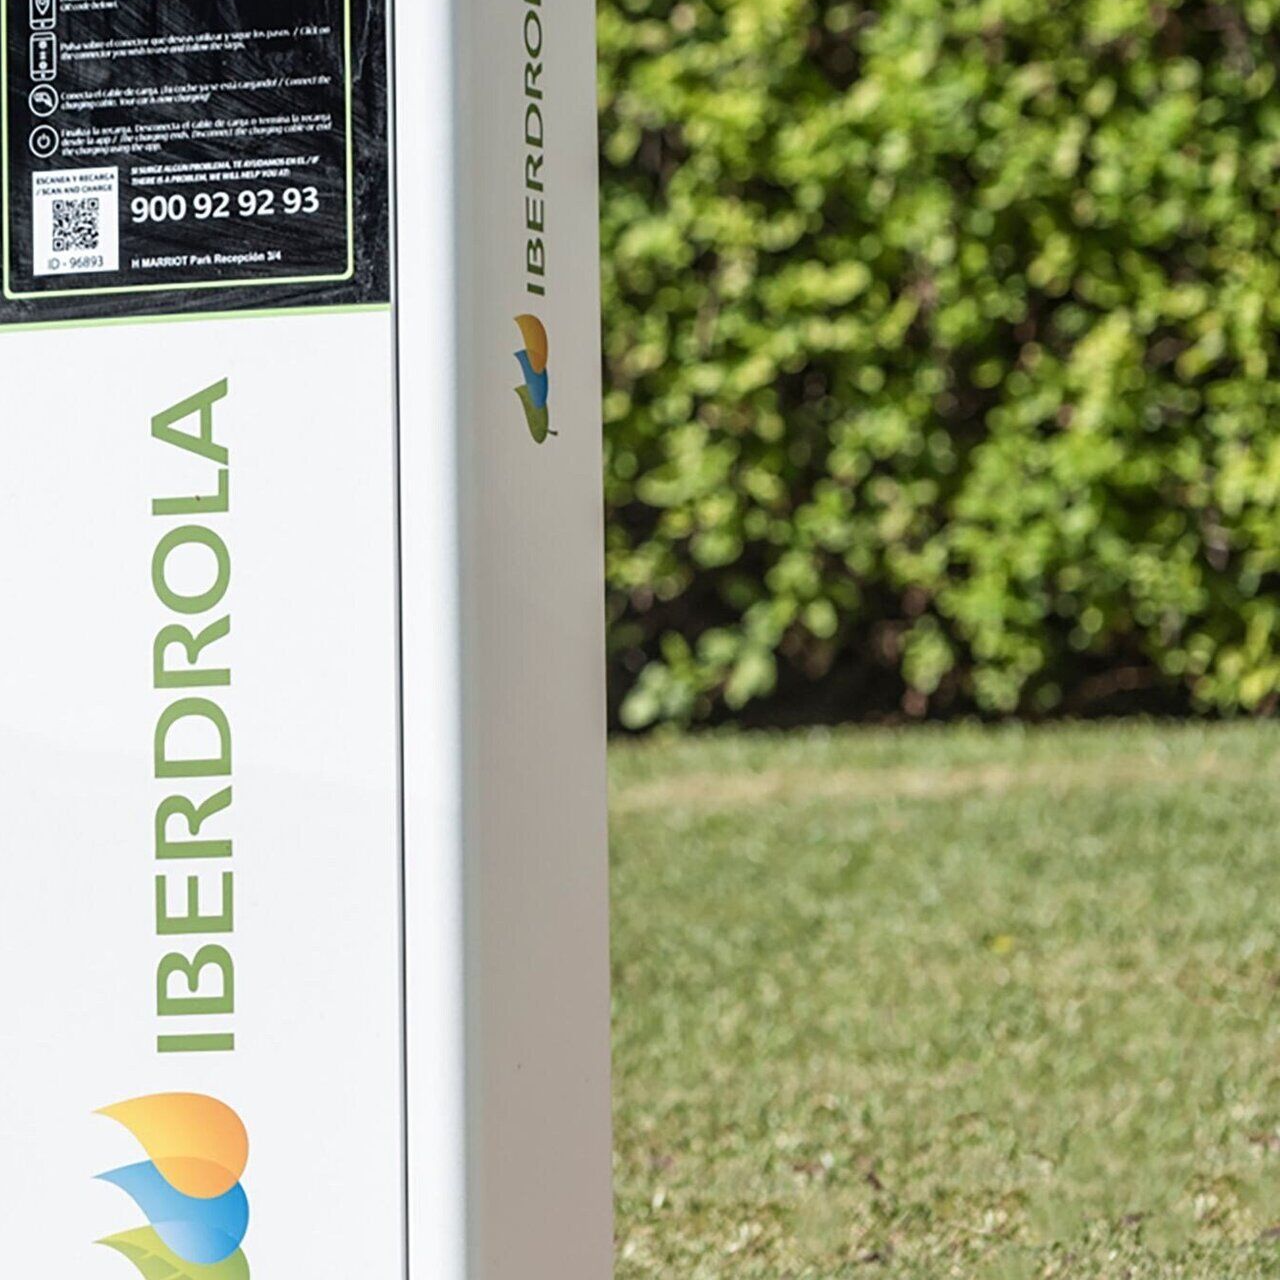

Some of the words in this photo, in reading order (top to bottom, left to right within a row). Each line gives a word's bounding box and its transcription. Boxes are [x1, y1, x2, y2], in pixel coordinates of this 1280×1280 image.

[36, 176, 70, 185] ESCANEA
[79, 173, 114, 182] RECARGA
[82, 184, 112, 193] CHARGE
[130, 194, 187, 223] 900
[193, 191, 230, 219] 92
[237, 189, 275, 217] 92
[282, 186, 320, 214] 93
[48, 258, 60, 270] ID
[69, 255, 103, 269] 96893
[131, 258, 140, 269] H
[142, 256, 188, 269] MARRIOT
[190, 254, 211, 265] Park
[214, 251, 265, 266] Recepción
[267, 250, 282, 261] 3/4
[151, 377, 235, 1053] IBERDROLA
